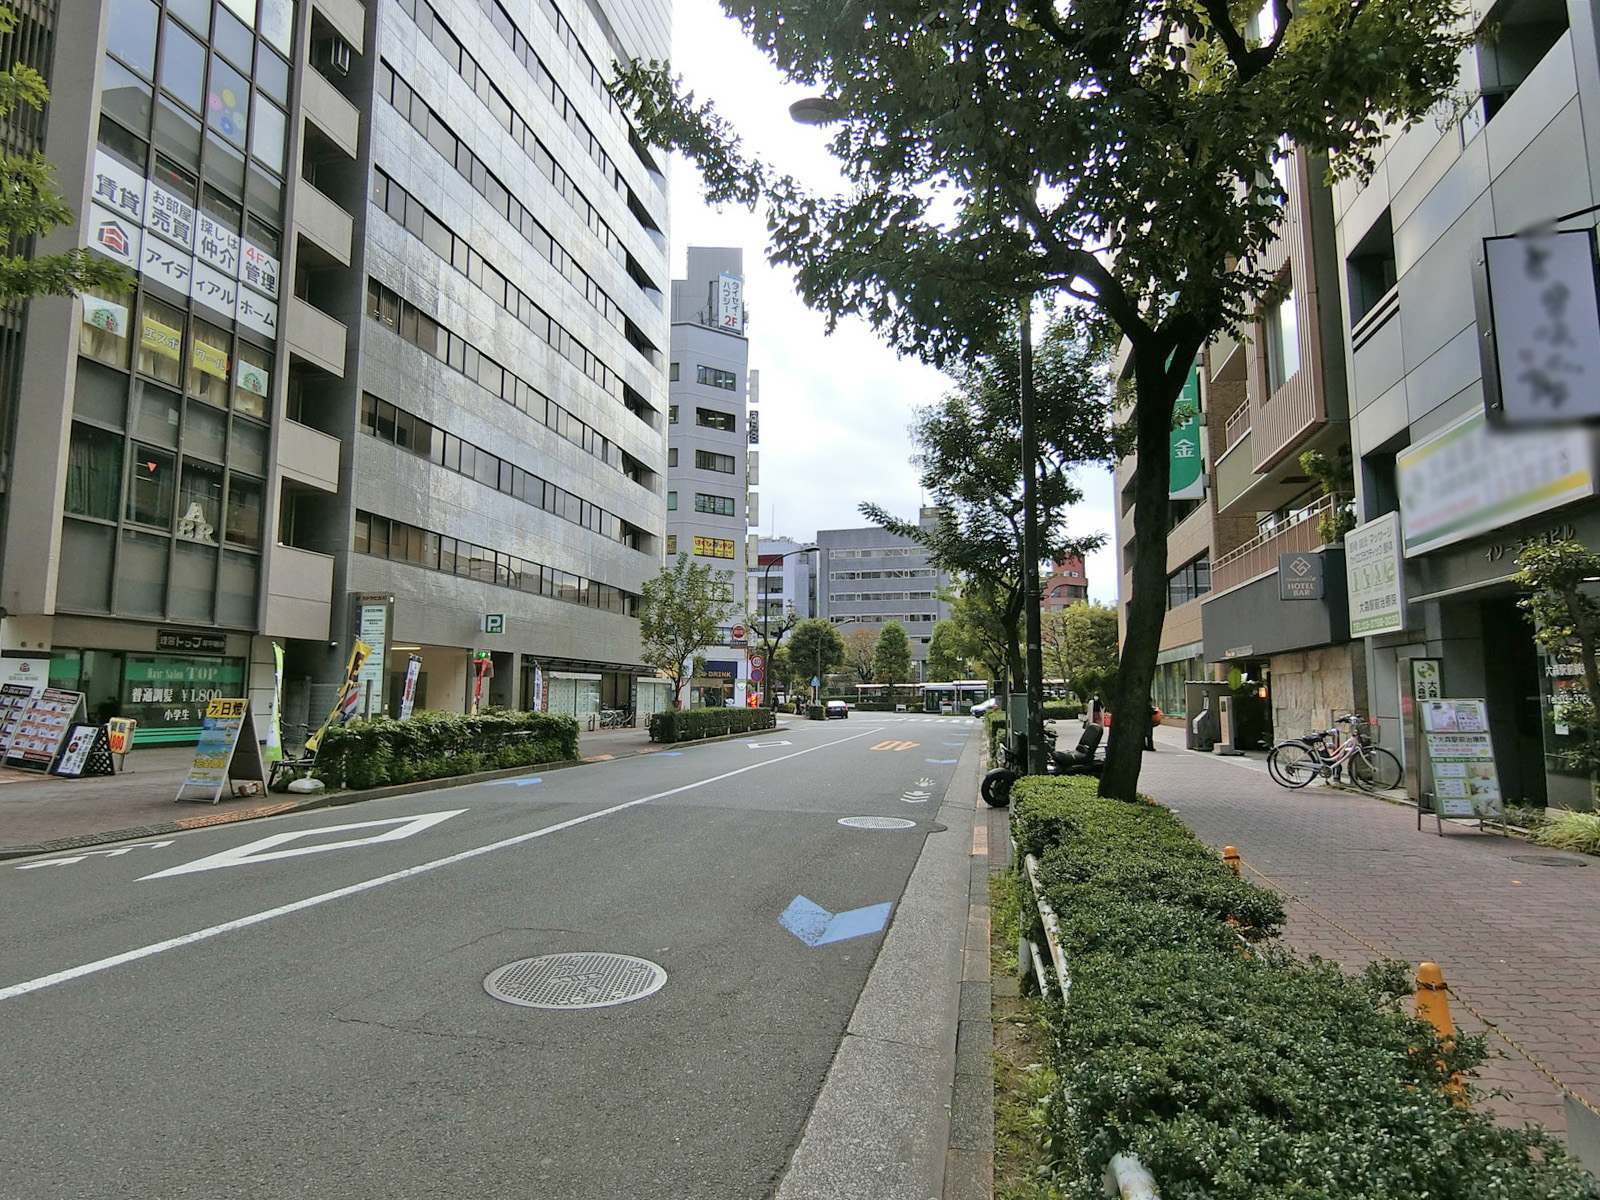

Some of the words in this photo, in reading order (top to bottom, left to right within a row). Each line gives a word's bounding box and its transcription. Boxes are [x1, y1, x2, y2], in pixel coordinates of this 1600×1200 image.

[95, 173, 140, 217] 賃貸
[151, 206, 190, 245] 売買
[201, 237, 236, 270] 仲介
[245, 261, 276, 293] 管理
[724, 315, 738, 327] 2F
[183, 501, 206, 523] A
[1287, 582, 1314, 590] HOTEL
[487, 615, 501, 632] P
[186, 666, 218, 680] TOP
[132, 688, 174, 703] 普通調髪
[164, 709, 190, 721] 小学生
